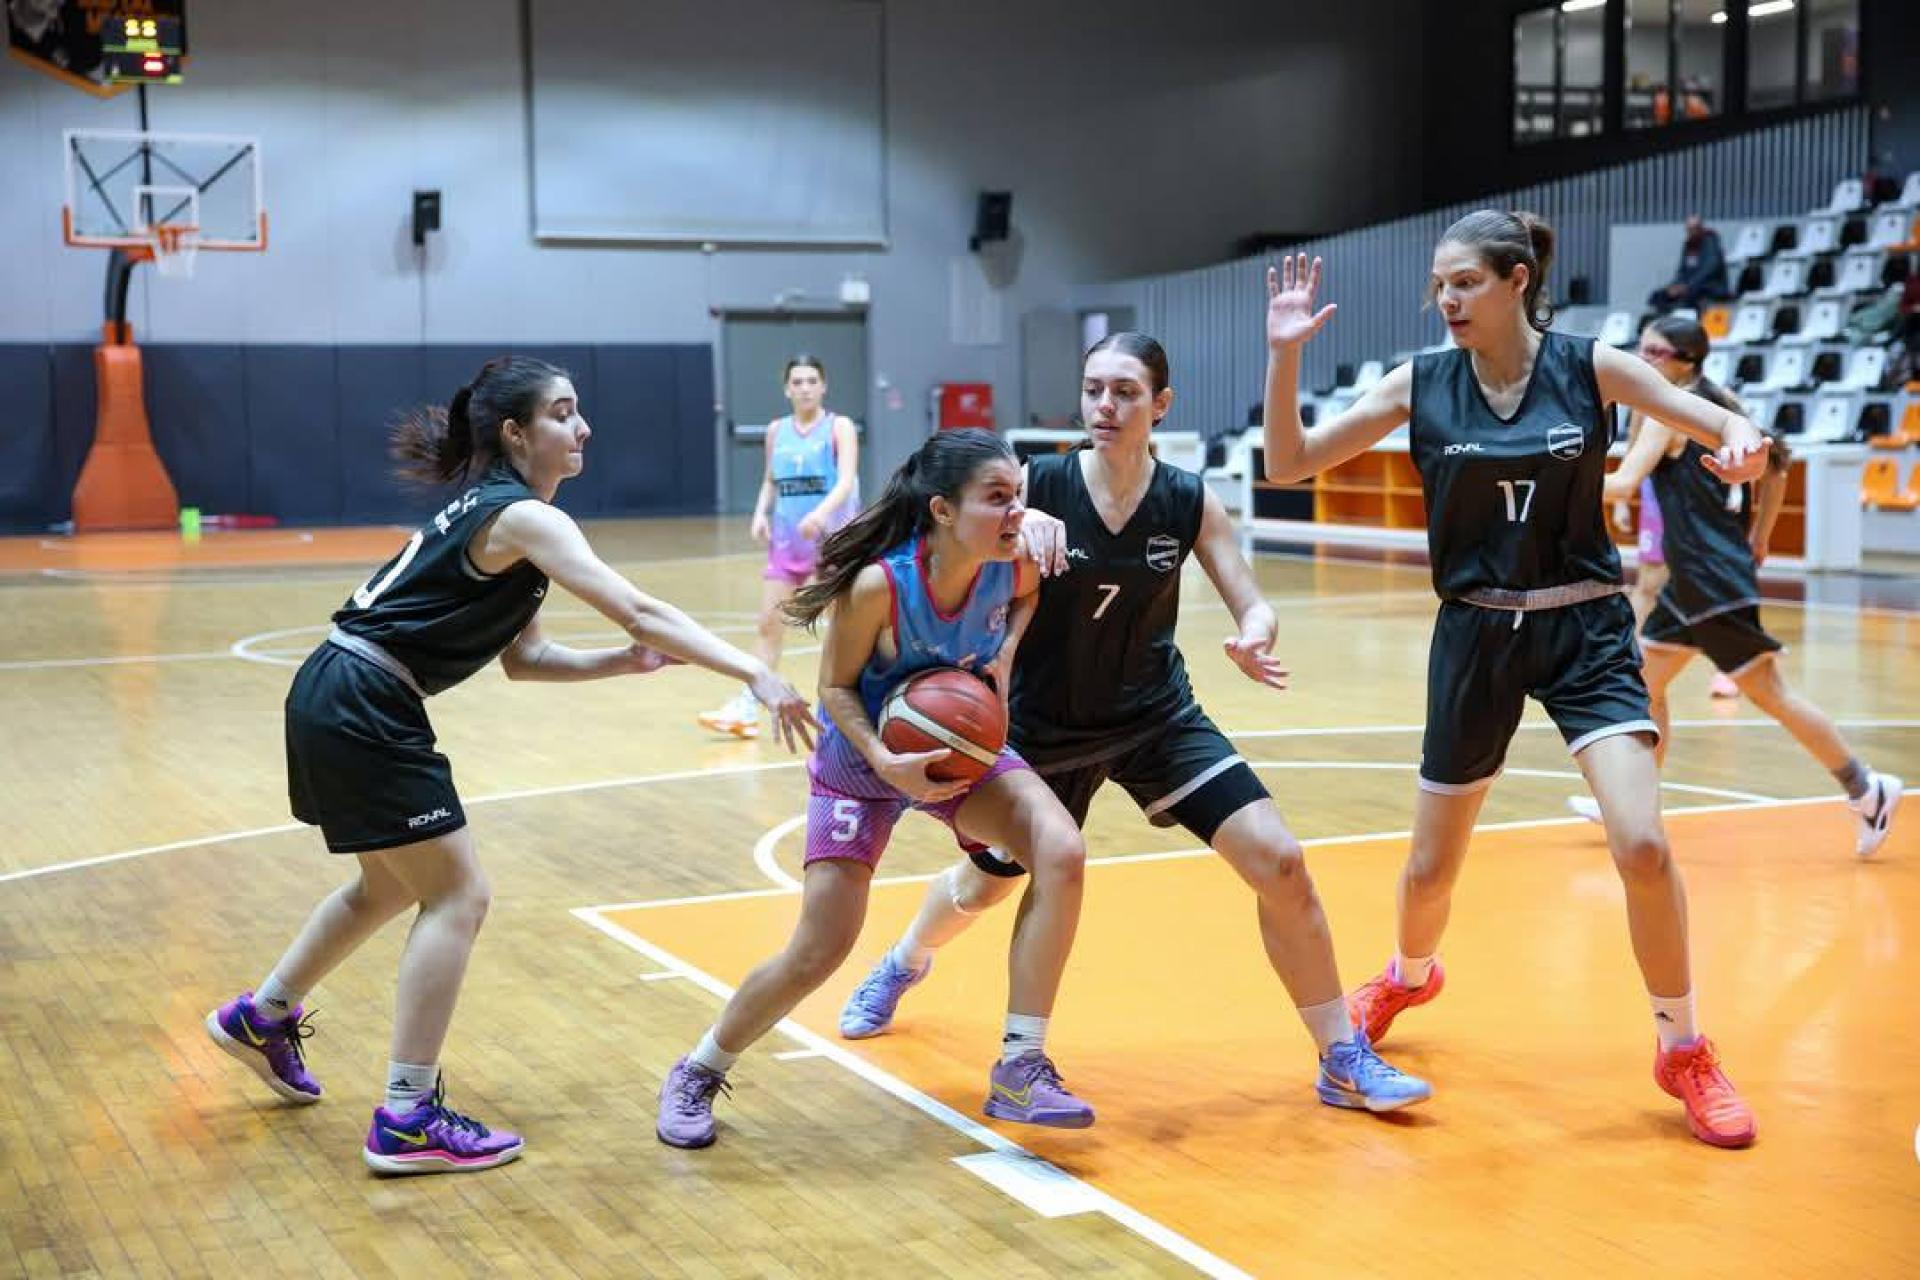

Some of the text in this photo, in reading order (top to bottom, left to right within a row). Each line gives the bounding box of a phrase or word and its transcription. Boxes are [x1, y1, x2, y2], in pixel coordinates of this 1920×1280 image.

[1497, 479, 1536, 522] 17
[1092, 584, 1121, 619] 7
[407, 806, 452, 829] ROYAL
[832, 799, 860, 841] 5
